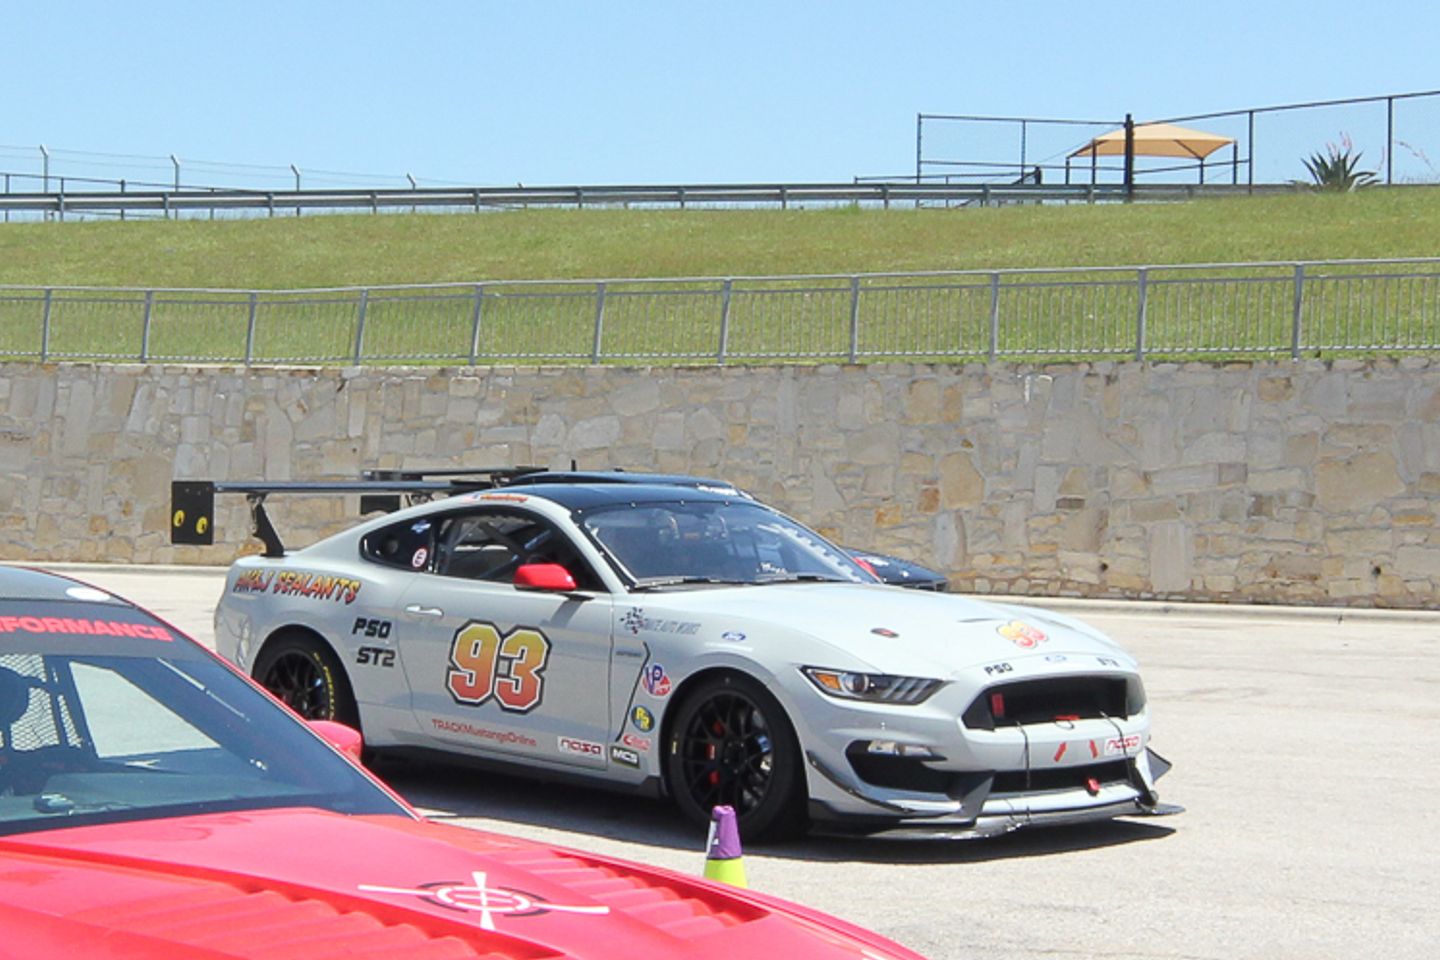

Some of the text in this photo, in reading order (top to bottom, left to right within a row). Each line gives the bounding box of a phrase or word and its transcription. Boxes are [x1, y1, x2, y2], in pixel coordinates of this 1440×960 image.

[273, 570, 361, 604] SEALANTS
[356, 646, 396, 668] ST2
[445, 618, 553, 715] 93
[613, 748, 638, 764] MCS
